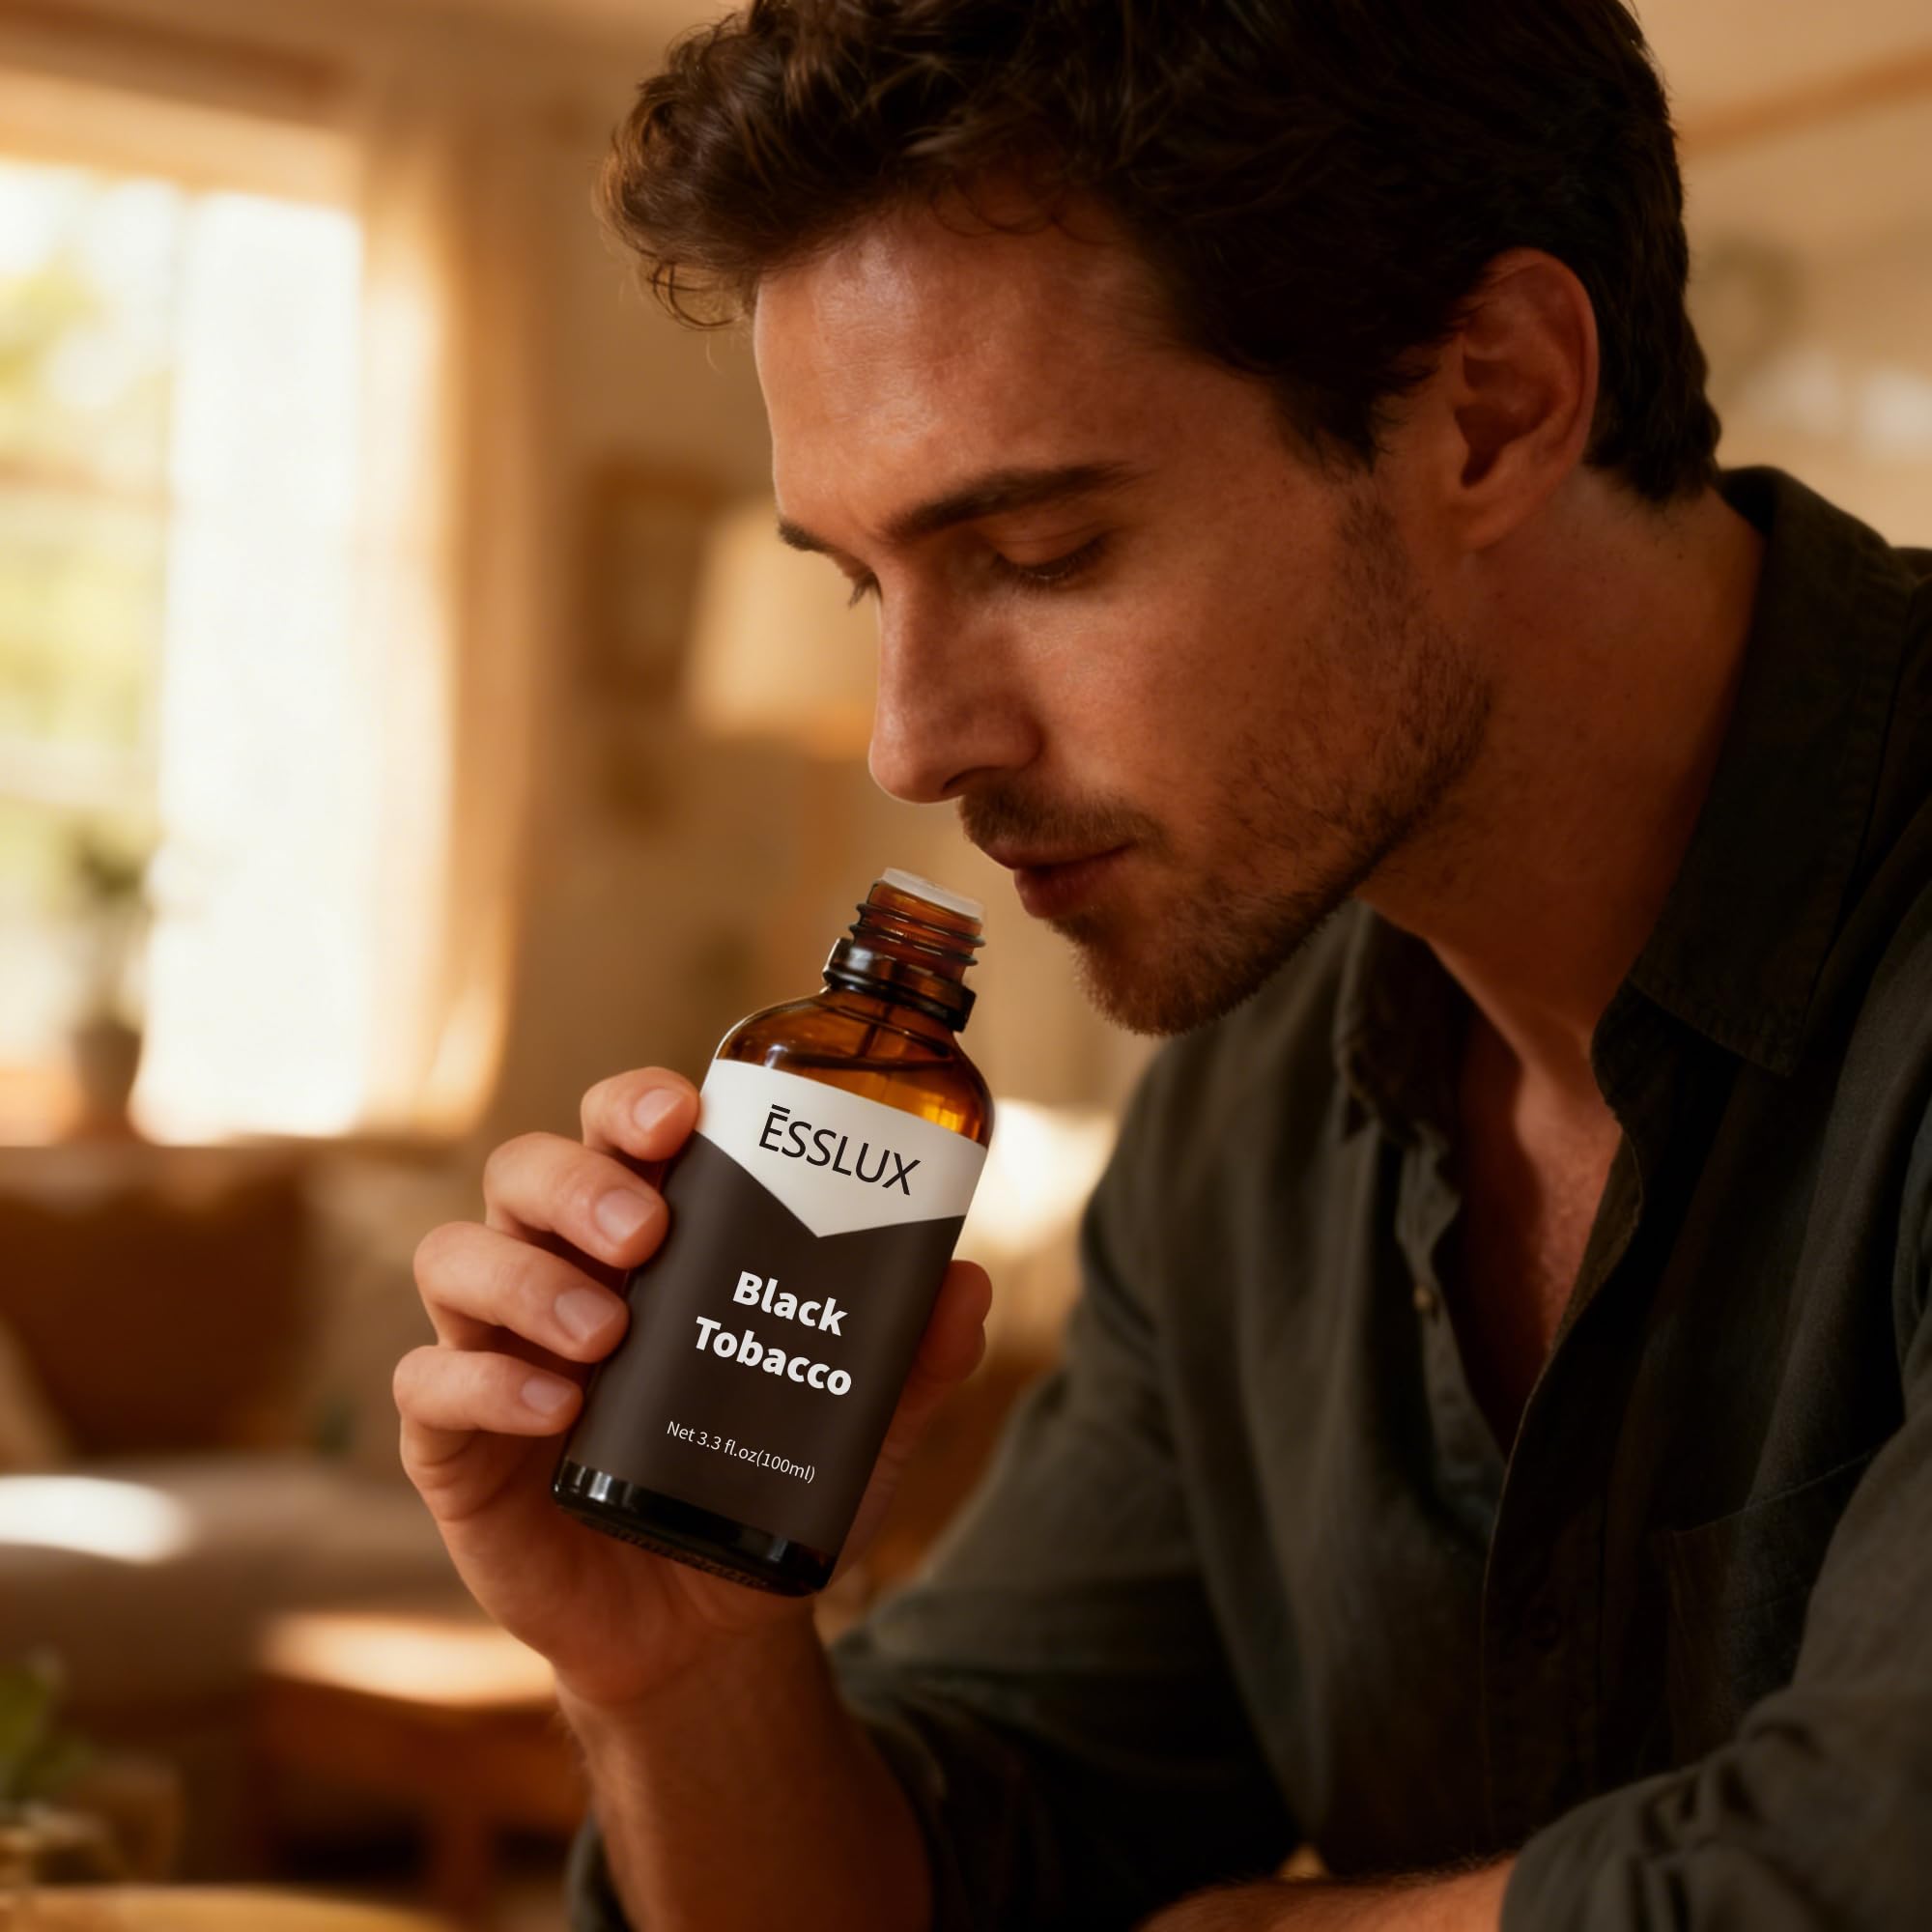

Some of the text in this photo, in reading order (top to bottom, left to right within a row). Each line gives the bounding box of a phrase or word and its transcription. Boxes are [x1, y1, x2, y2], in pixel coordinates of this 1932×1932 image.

[732, 1270, 848, 1337] Black
[695, 1316, 852, 1396] Tobacco
[667, 1420, 815, 1484] Net 3.3 fl.oz(100ml)
